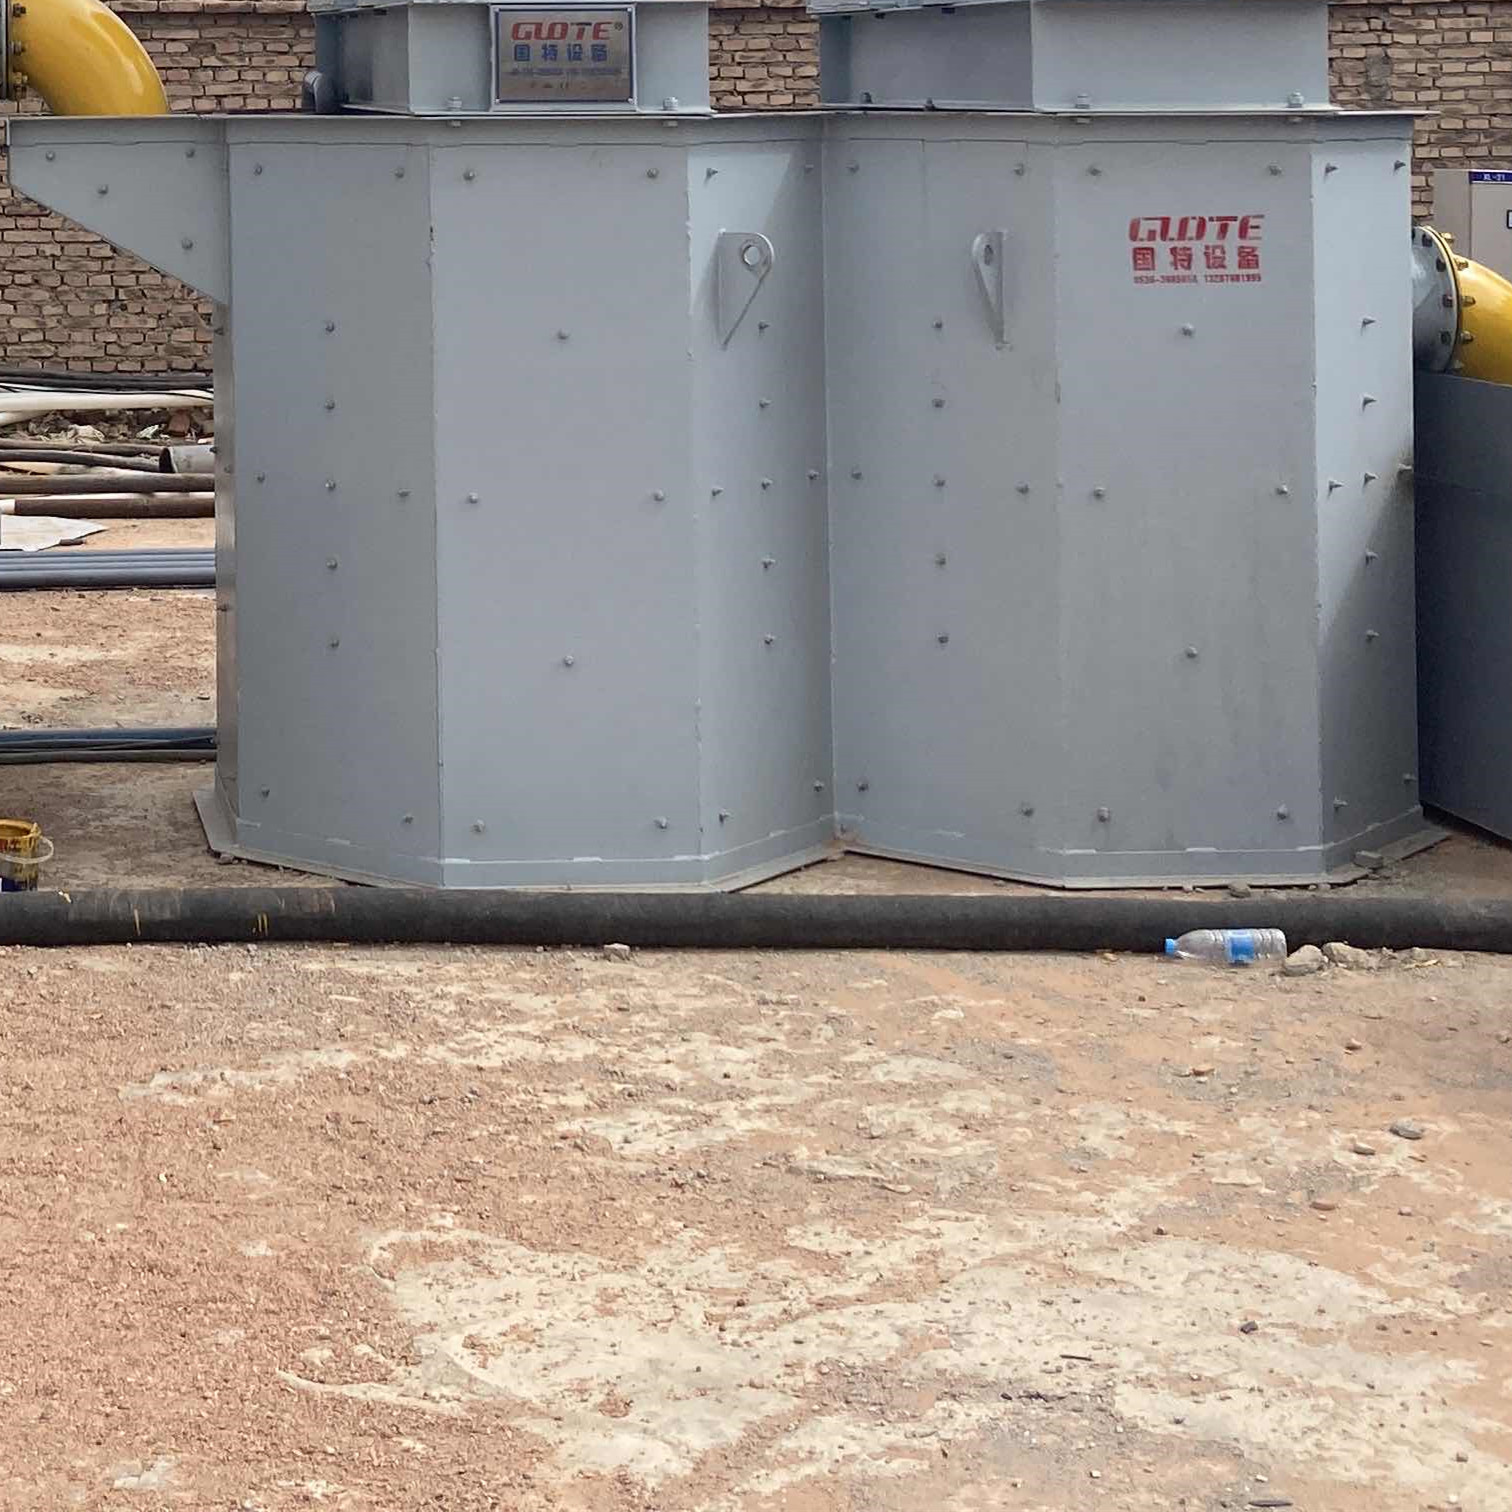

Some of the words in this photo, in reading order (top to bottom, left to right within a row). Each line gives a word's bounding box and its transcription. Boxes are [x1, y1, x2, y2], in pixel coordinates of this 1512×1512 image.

[514, 43, 608, 62] 国特设备
[1132, 245, 1260, 271] 国特设备
